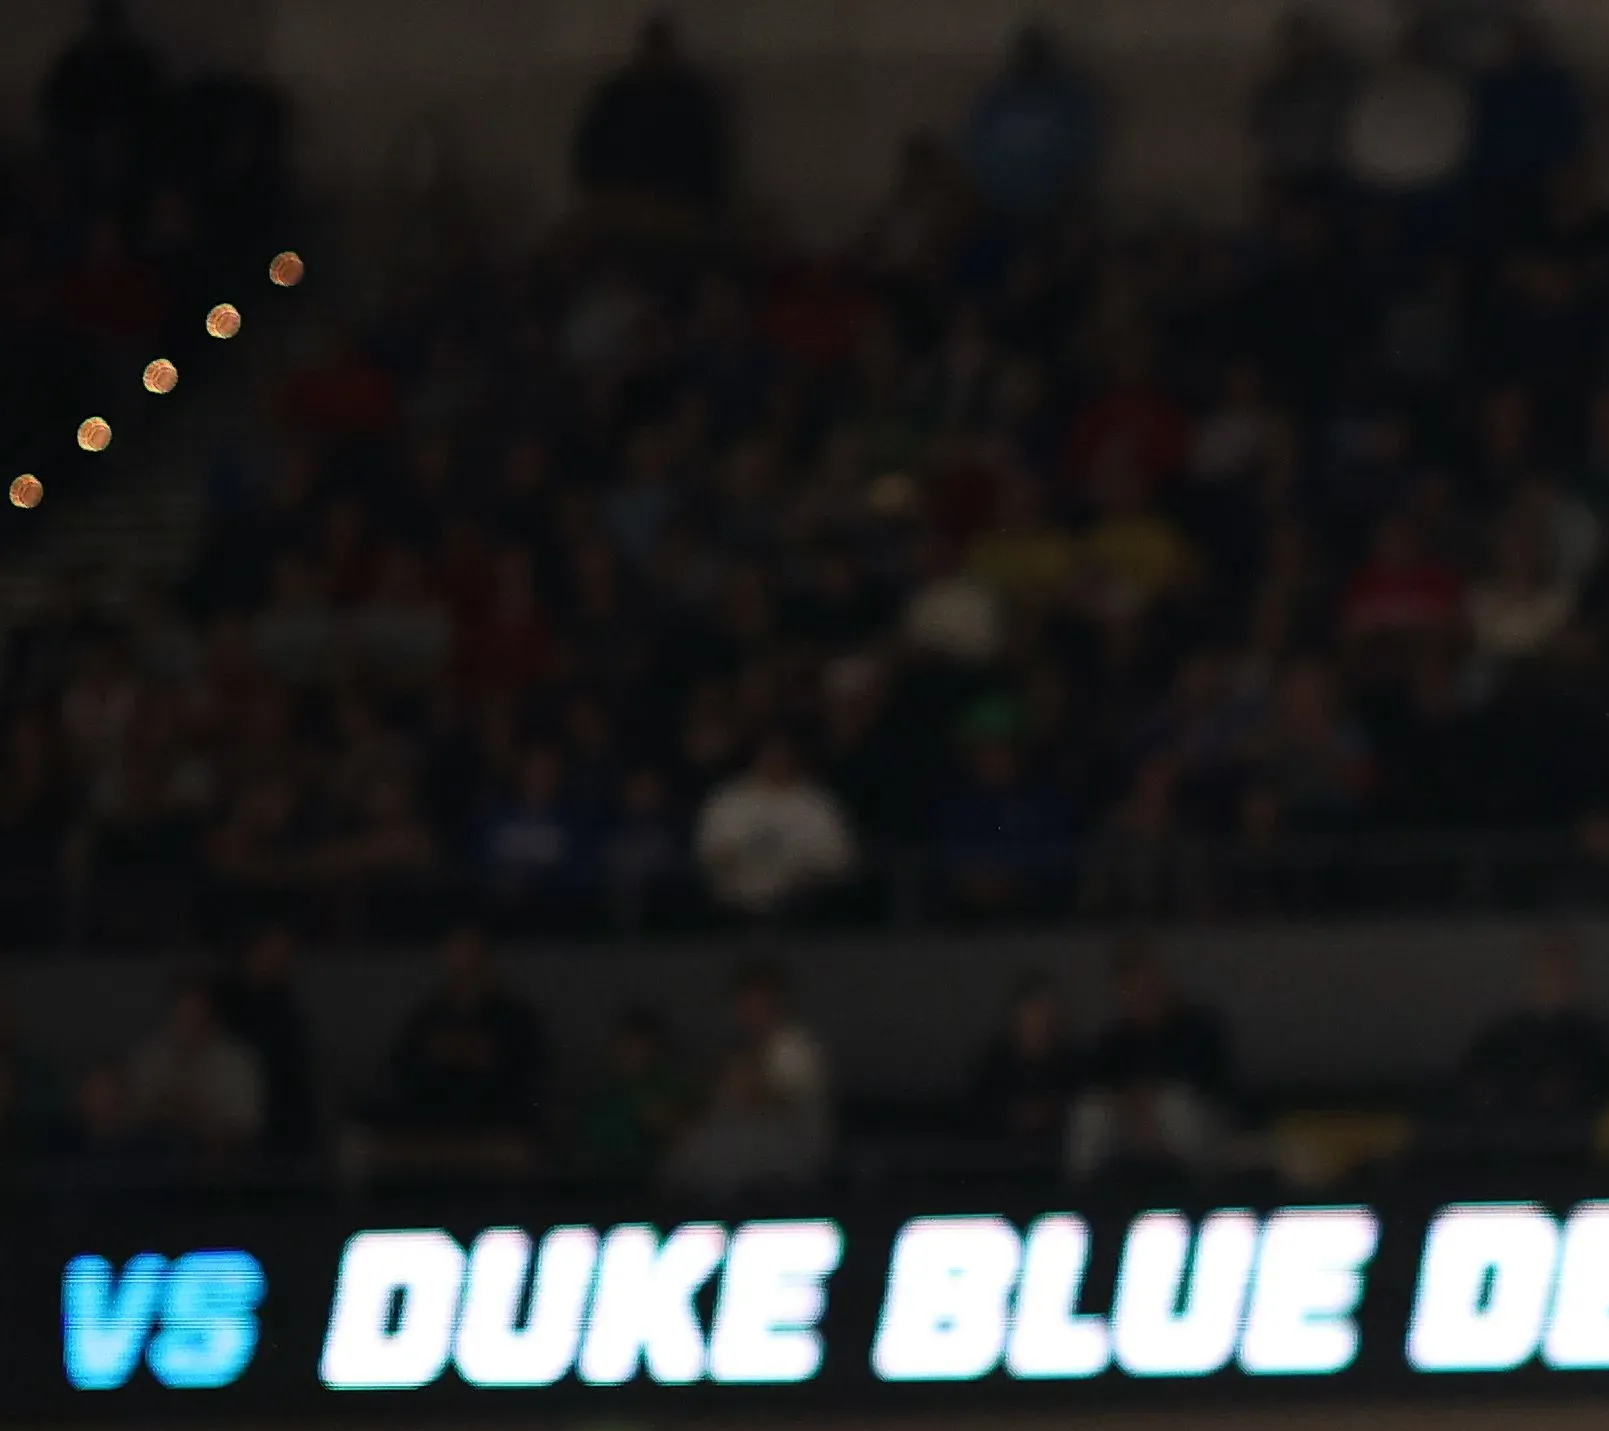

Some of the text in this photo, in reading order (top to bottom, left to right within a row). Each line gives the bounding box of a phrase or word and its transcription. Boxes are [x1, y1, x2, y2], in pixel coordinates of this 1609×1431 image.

[62, 1251, 265, 1392] VS
[320, 1218, 843, 1391] DUKE
[872, 1205, 1380, 1383] BLUE
